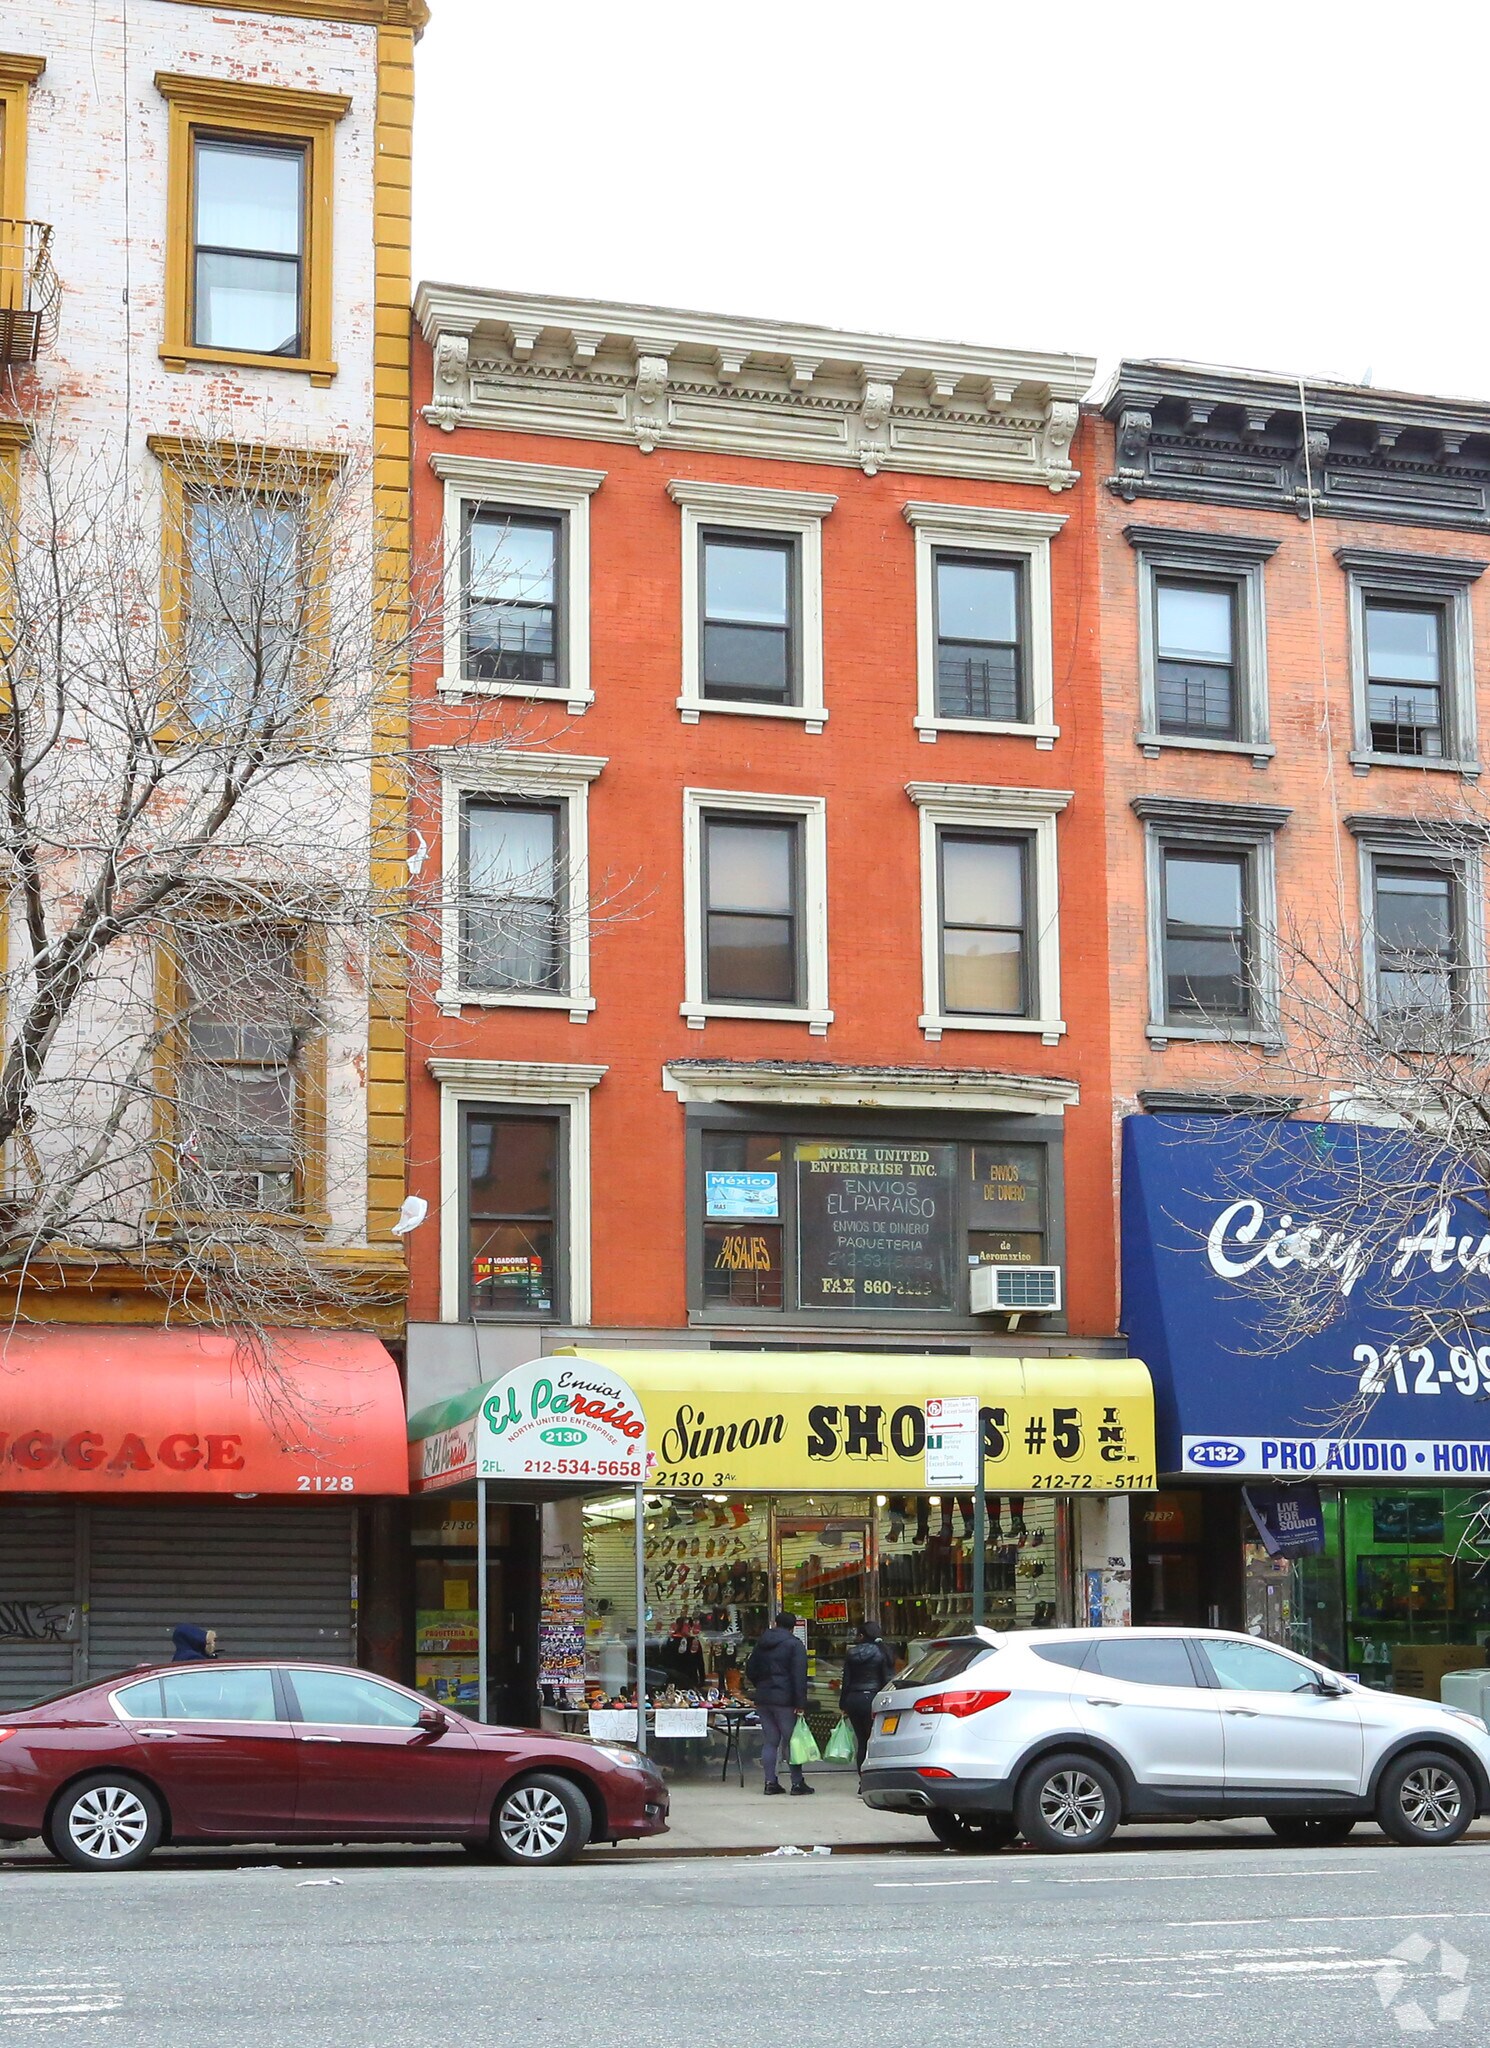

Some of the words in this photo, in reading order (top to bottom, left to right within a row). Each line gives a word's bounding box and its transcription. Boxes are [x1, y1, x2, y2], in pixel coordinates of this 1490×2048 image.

[818, 1147, 868, 1161] NORTH
[875, 1149, 930, 1162] UNITED
[810, 1161, 903, 1176] ENTERPRISE
[910, 1164, 937, 1176] INC.
[990, 1164, 1019, 1182] ENVIOS
[711, 1176, 771, 1185] México
[842, 1179, 918, 1196] ENVIOS
[983, 1184, 995, 1201] DE
[998, 1184, 1026, 1202] DINERO
[826, 1193, 849, 1215] EL
[854, 1195, 936, 1219] PARAISO
[833, 1220, 870, 1233] ENVIOS
[873, 1221, 886, 1233] DE
[890, 1222, 930, 1235] DINERO
[837, 1236, 923, 1250] PAQUETERIA
[1000, 1240, 1011, 1250] de
[714, 1236, 772, 1272] PASAJES
[821, 1277, 856, 1294] FAX
[557, 1371, 622, 1400] Envios
[483, 1387, 522, 1435] El
[531, 1379, 645, 1439] Paraiso
[507, 1422, 535, 1443] NORTH
[537, 1416, 568, 1427] UNITED
[570, 1417, 618, 1446] ENTERPRISE
[545, 1432, 582, 1443] 2130
[661, 1404, 789, 1464] Simon
[807, 1405, 1009, 1463] SHOS
[1024, 1408, 1085, 1463] #5
[1192, 1447, 1239, 1462] 2132
[1261, 1442, 1316, 1470] PRO
[1325, 1442, 1407, 1471] AUDIO
[524, 1459, 641, 1476] 212-534-5658
[296, 1476, 355, 1492] 2128
[656, 1472, 704, 1487] 2130
[1276, 1501, 1299, 1513] LIVE
[1278, 1511, 1300, 1522] FOR
[1279, 1517, 1317, 1531] SOUND
[442, 1520, 476, 1531] 2130
